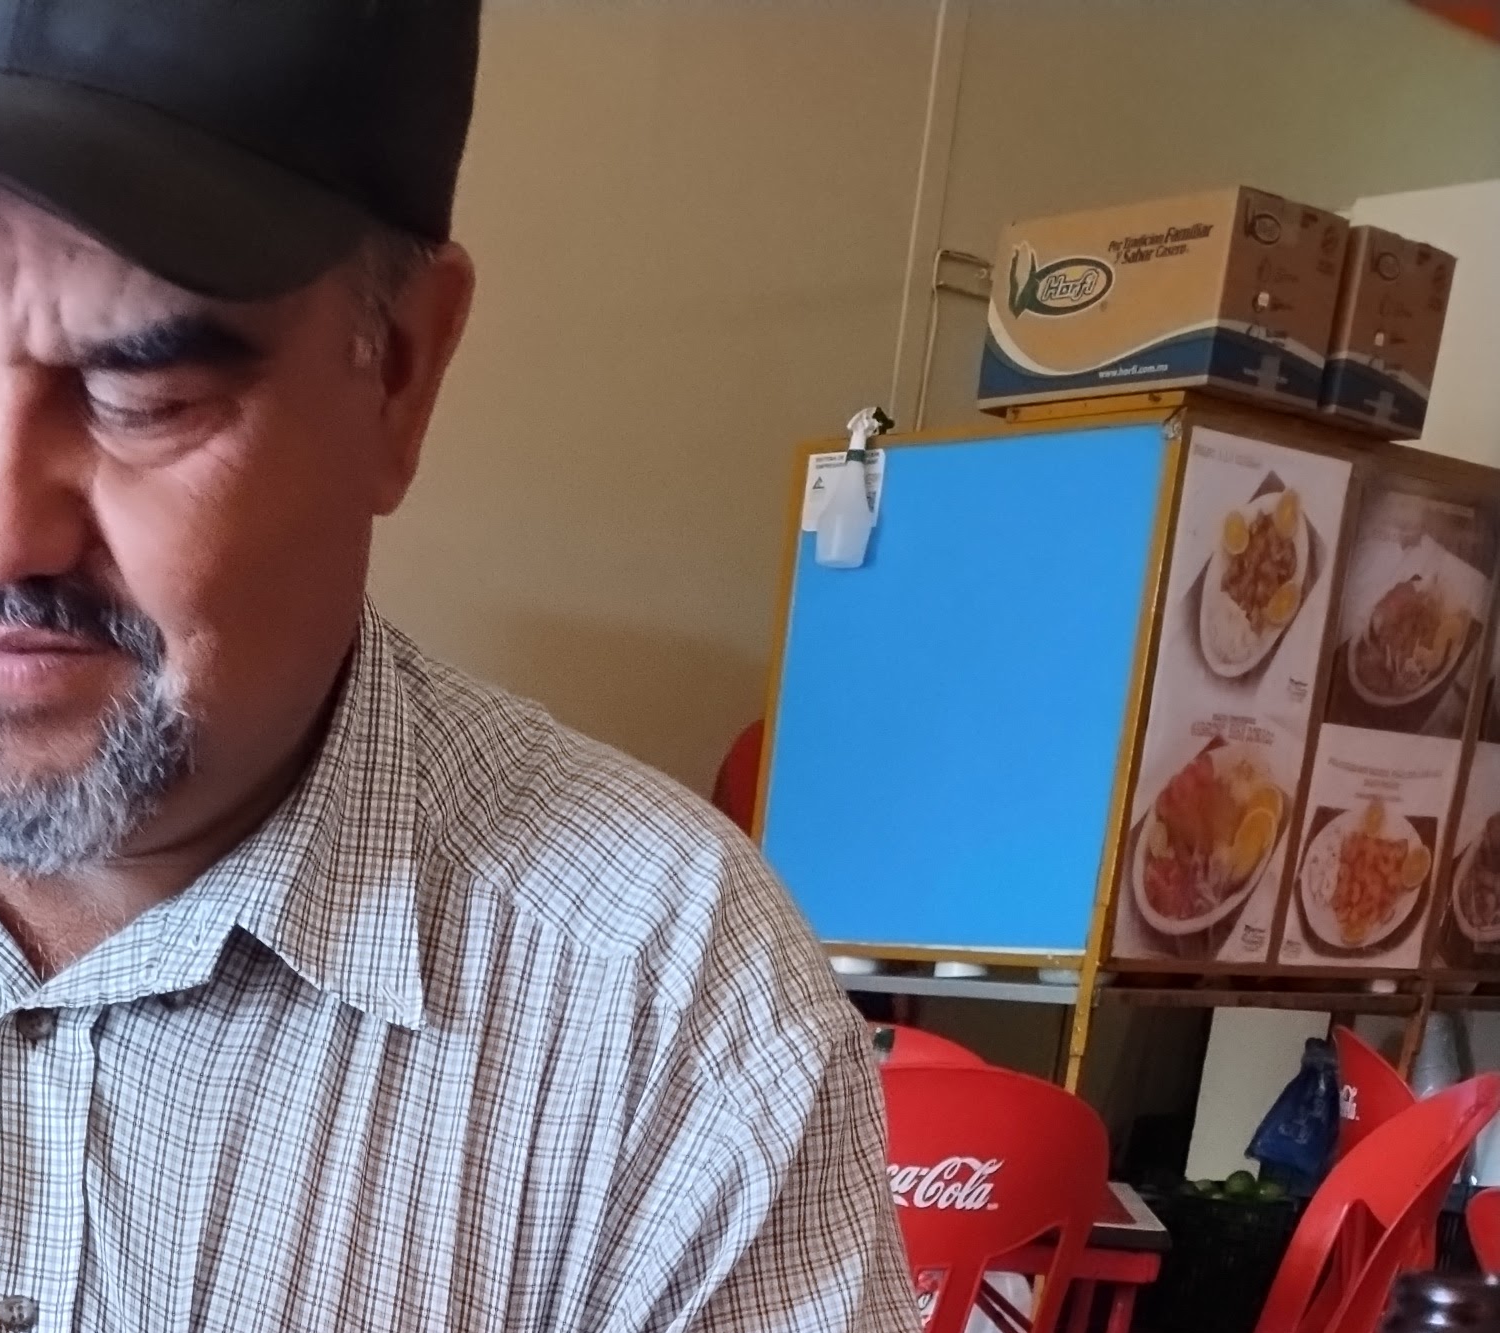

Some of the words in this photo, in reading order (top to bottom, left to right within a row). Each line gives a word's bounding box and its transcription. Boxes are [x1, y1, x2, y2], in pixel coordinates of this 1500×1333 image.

[1164, 222, 1214, 243] Familiar
[1121, 247, 1155, 264] Sabor
[1042, 269, 1098, 301] Horfi
[886, 1156, 1005, 1210] ca-Cola
